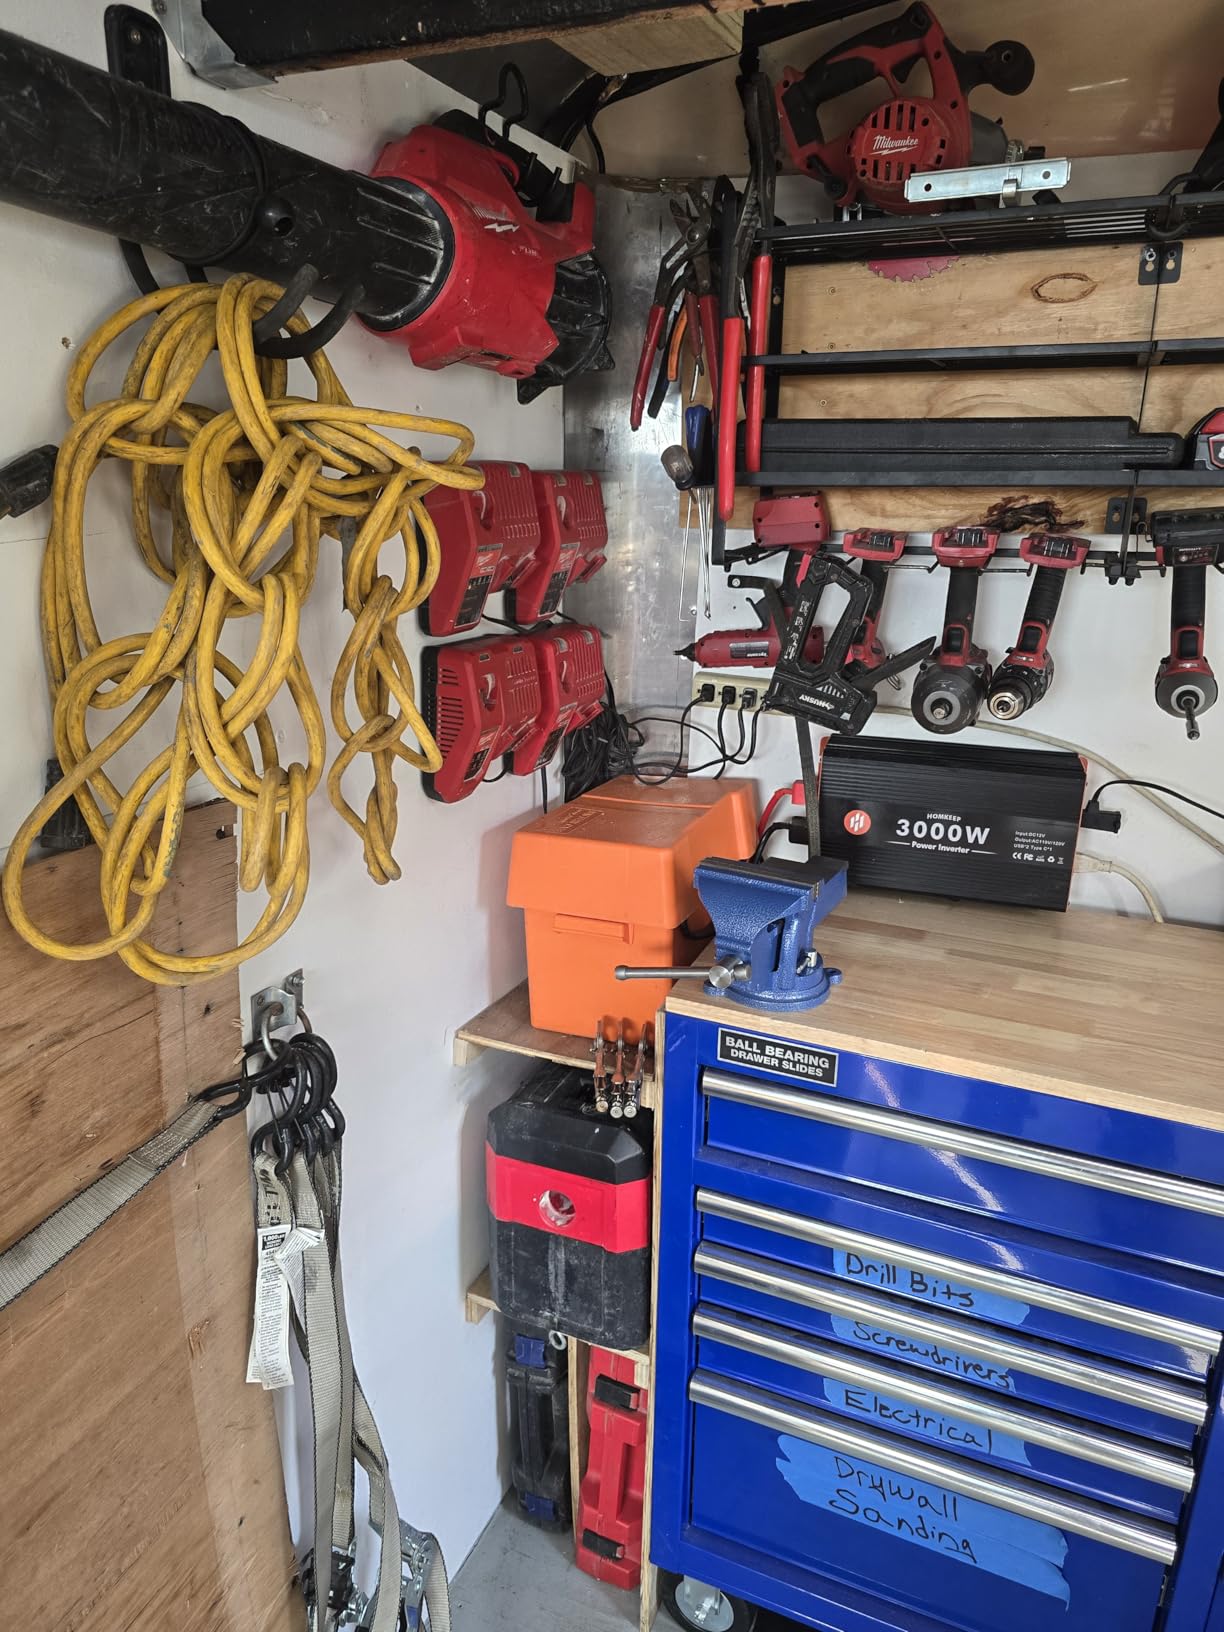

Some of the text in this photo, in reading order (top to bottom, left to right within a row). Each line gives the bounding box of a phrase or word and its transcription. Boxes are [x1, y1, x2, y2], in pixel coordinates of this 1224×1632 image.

[872, 134, 919, 151] Milwaukee
[799, 694, 827, 708] HUSKY
[895, 818, 991, 845] 3000W
[926, 813, 962, 822] HOMKEEP
[911, 840, 970, 854] Power Inverter
[725, 1036, 830, 1069] BALL BEARING
[730, 1048, 824, 1077] DRAWER SLIDES
[846, 1252, 975, 1308] Drill Bits
[853, 1320, 1010, 1389] Screwdrivers
[844, 1388, 993, 1455] Electrical
[834, 1456, 958, 1523] Drywall
[828, 1488, 978, 1565] Sanding
